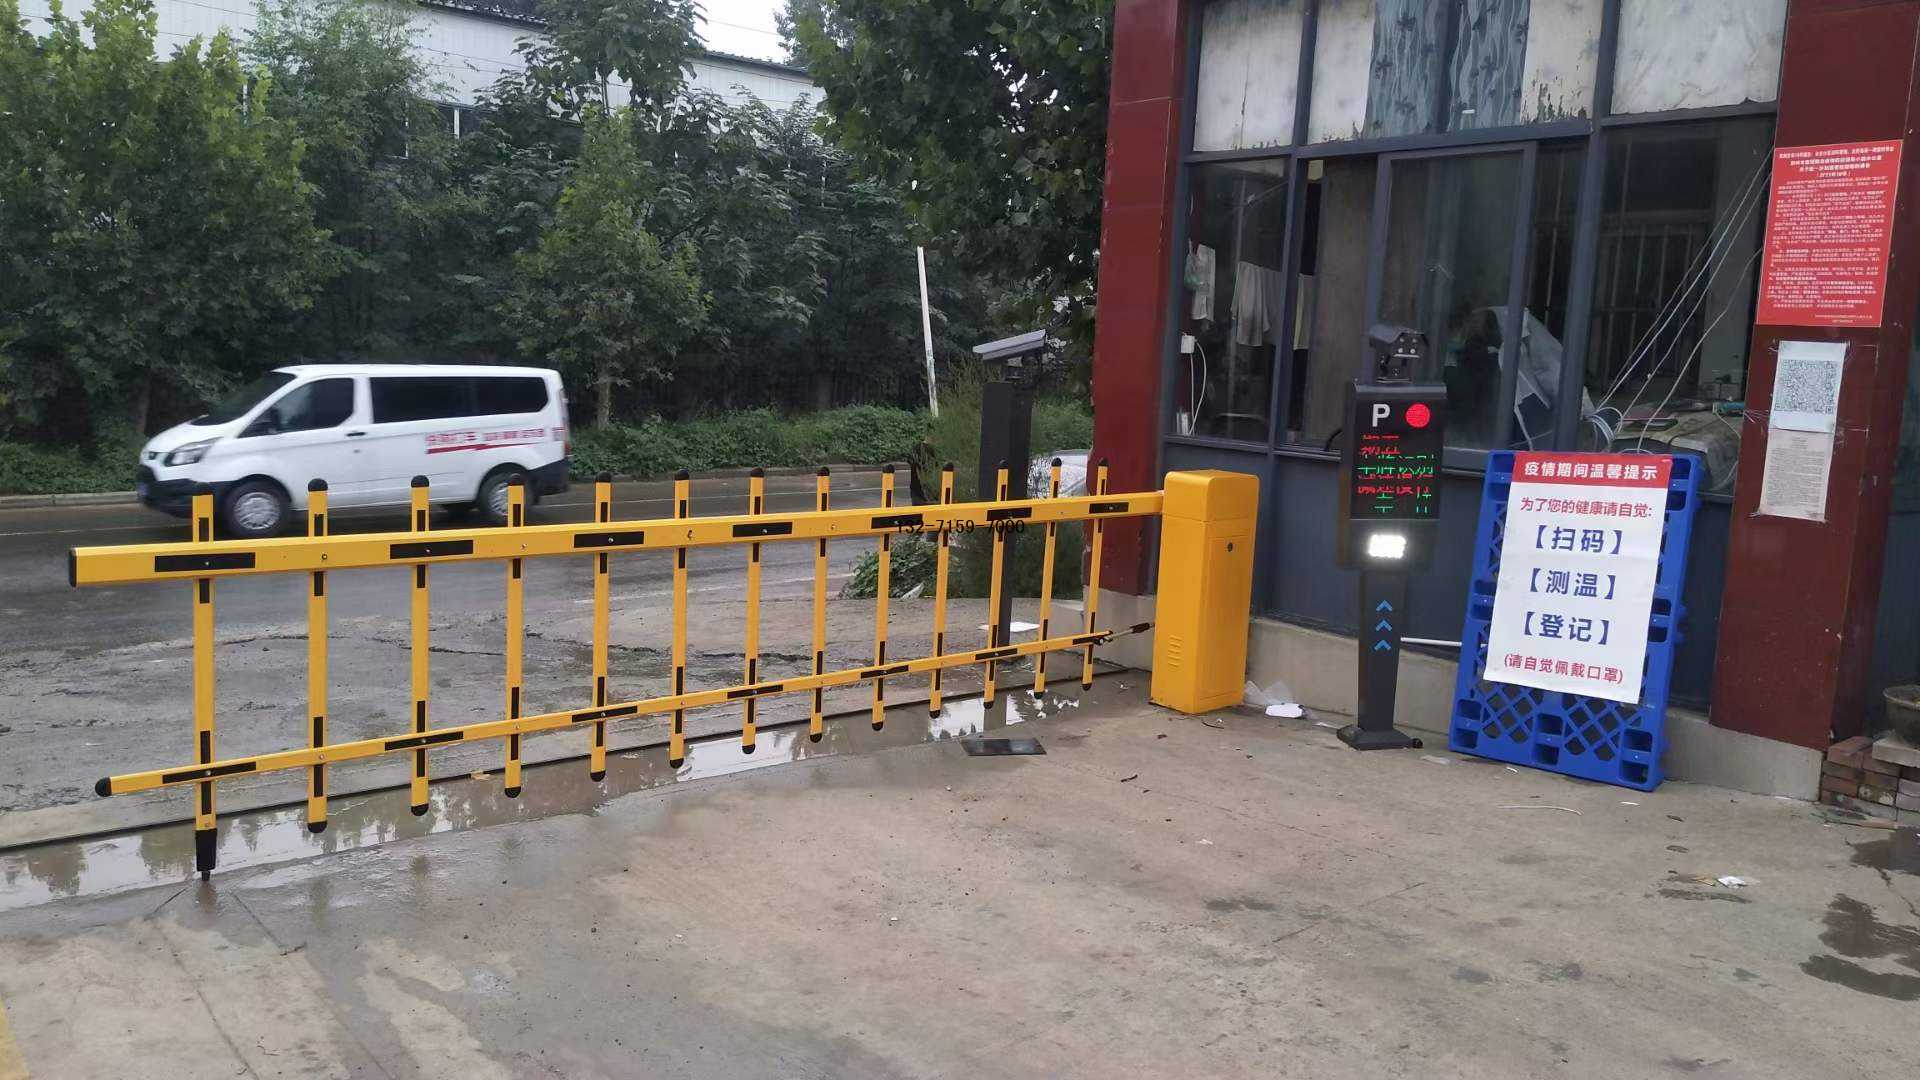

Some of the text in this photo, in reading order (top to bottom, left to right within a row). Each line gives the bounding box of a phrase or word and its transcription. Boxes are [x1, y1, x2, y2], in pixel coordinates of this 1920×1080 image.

[1372, 404, 1390, 427] P
[1524, 461, 1659, 481] 疫情期间温馨提示
[1504, 653, 1624, 684] (请自觉佩戴口罩)
